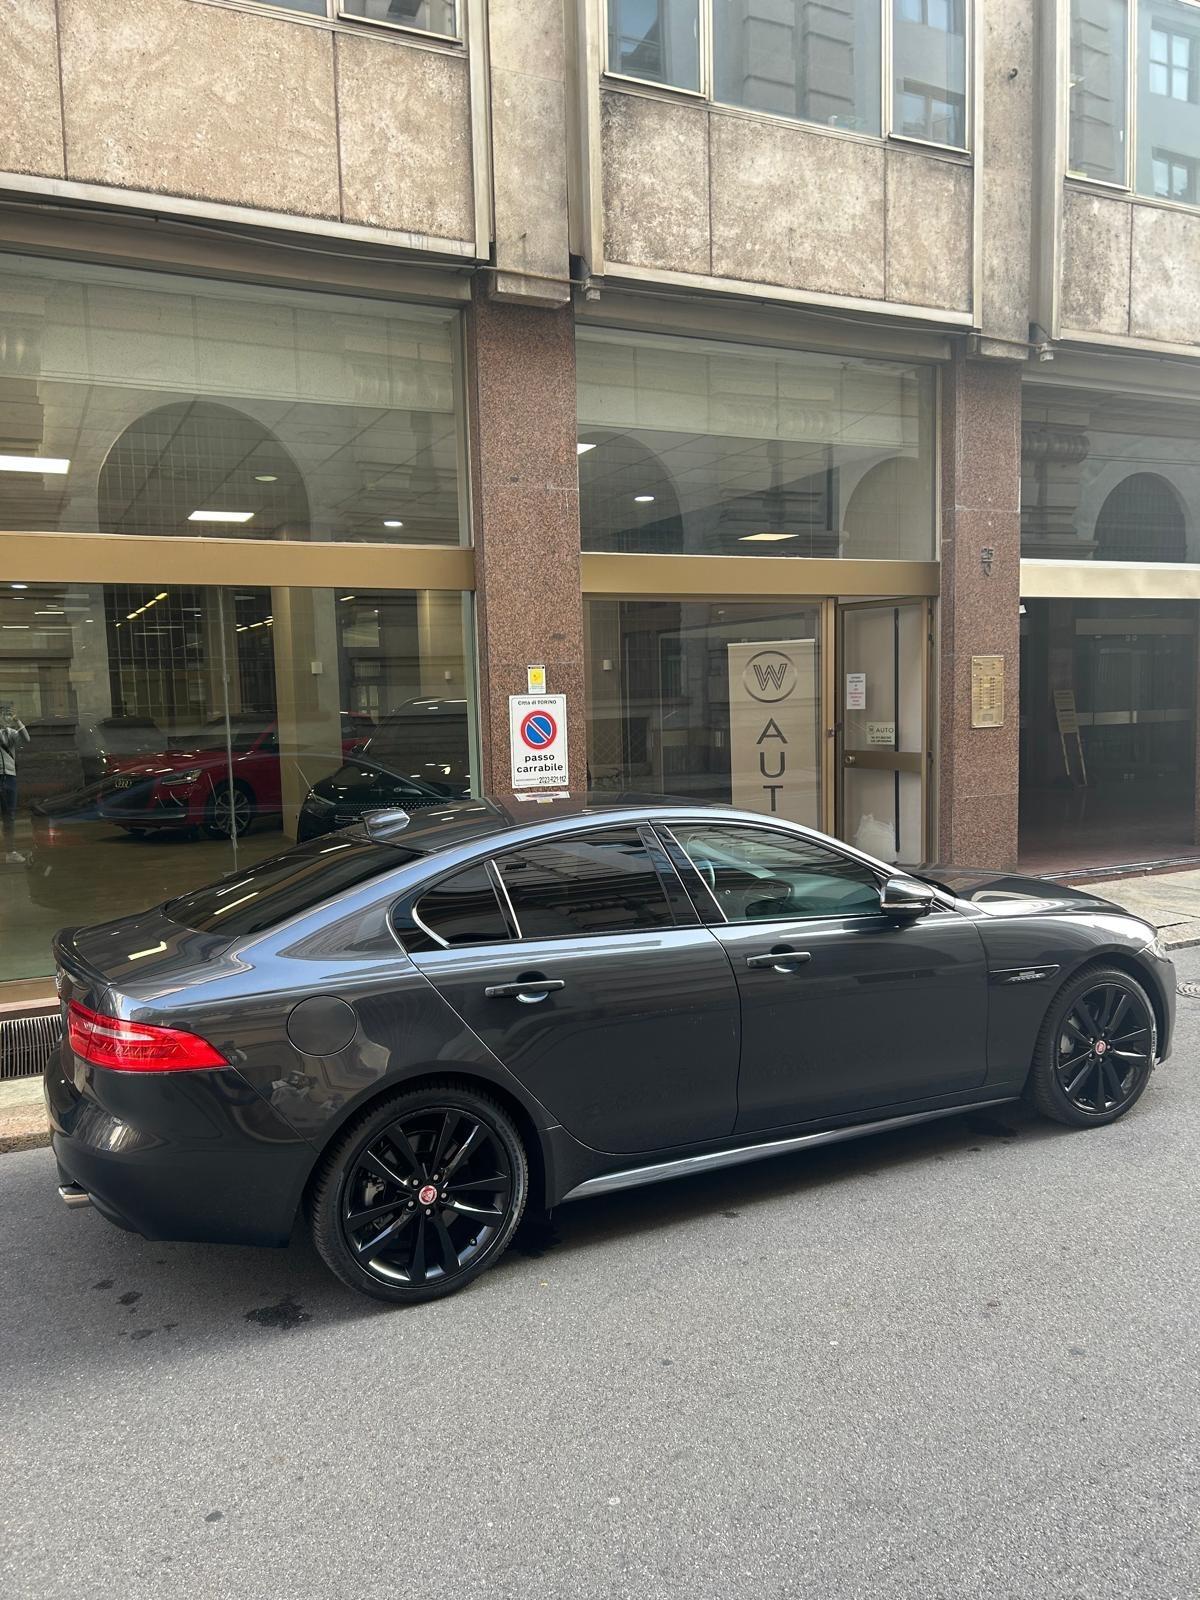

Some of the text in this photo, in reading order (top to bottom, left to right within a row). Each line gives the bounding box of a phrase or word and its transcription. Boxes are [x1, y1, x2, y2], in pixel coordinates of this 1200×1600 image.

[753, 663, 788, 691] W
[524, 754, 555, 763] passo
[516, 763, 563, 773] carrabile
